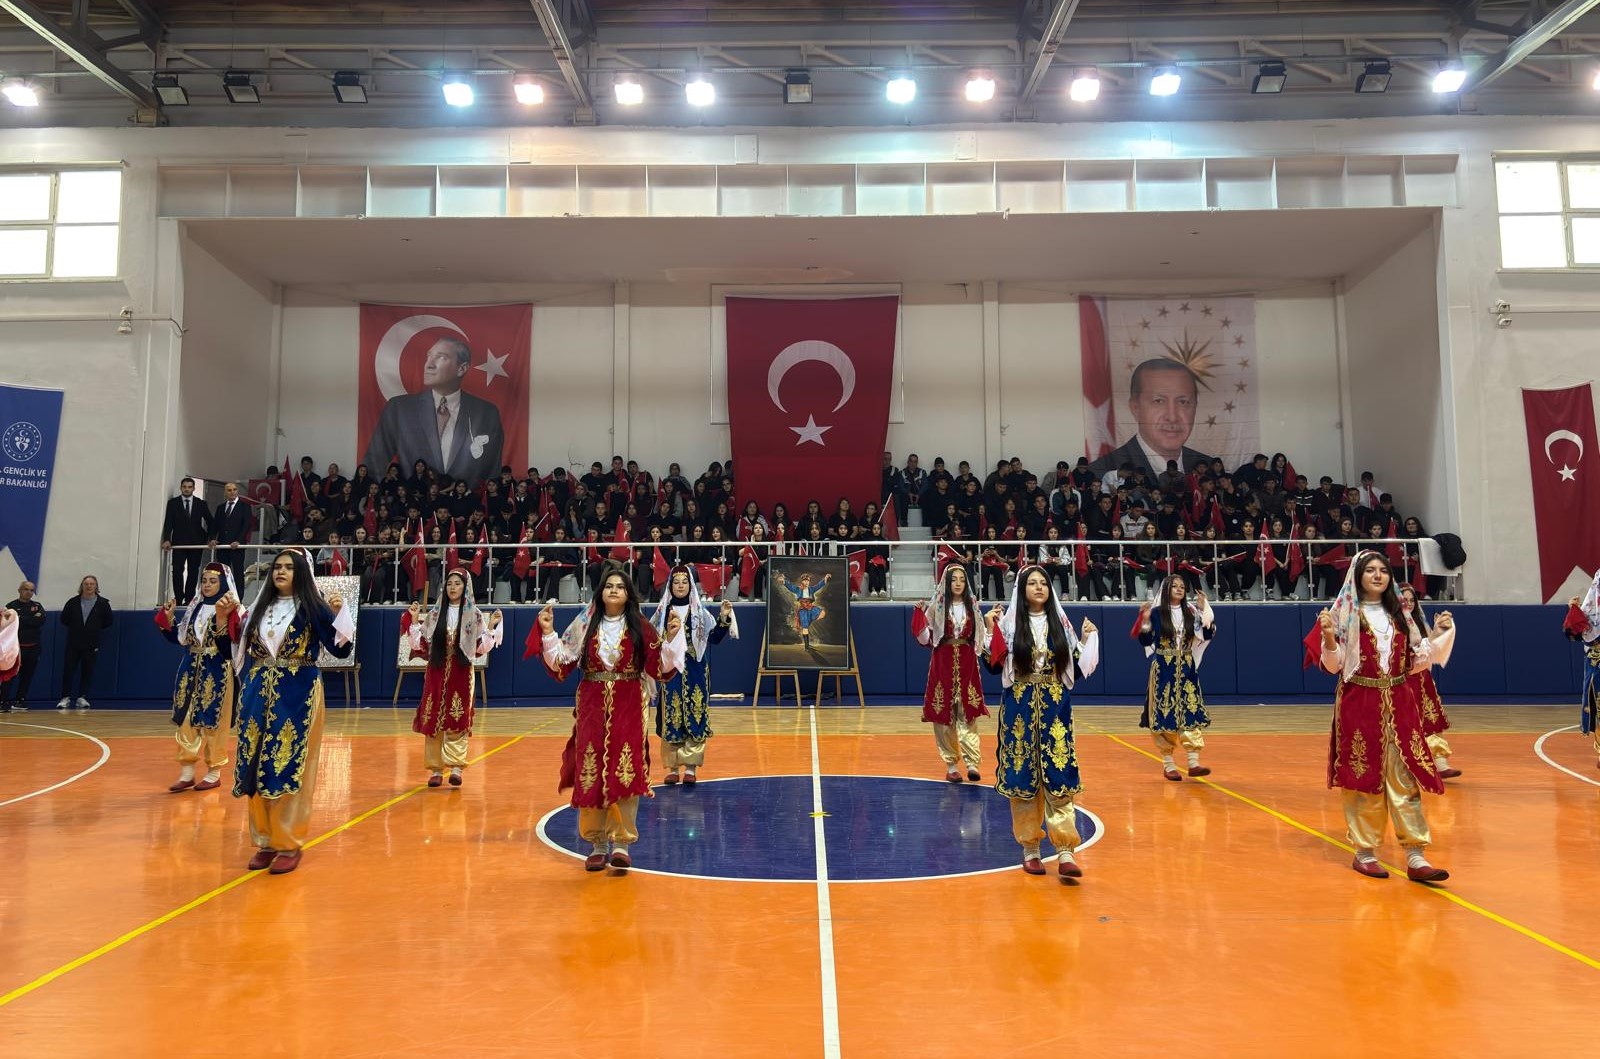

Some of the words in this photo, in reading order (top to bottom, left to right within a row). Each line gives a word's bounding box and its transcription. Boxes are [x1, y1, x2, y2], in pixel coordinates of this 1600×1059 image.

[3, 466, 35, 477] GENÇLİK
[37, 469, 47, 477] VE
[6, 478, 47, 488] BAKANLIĞI
